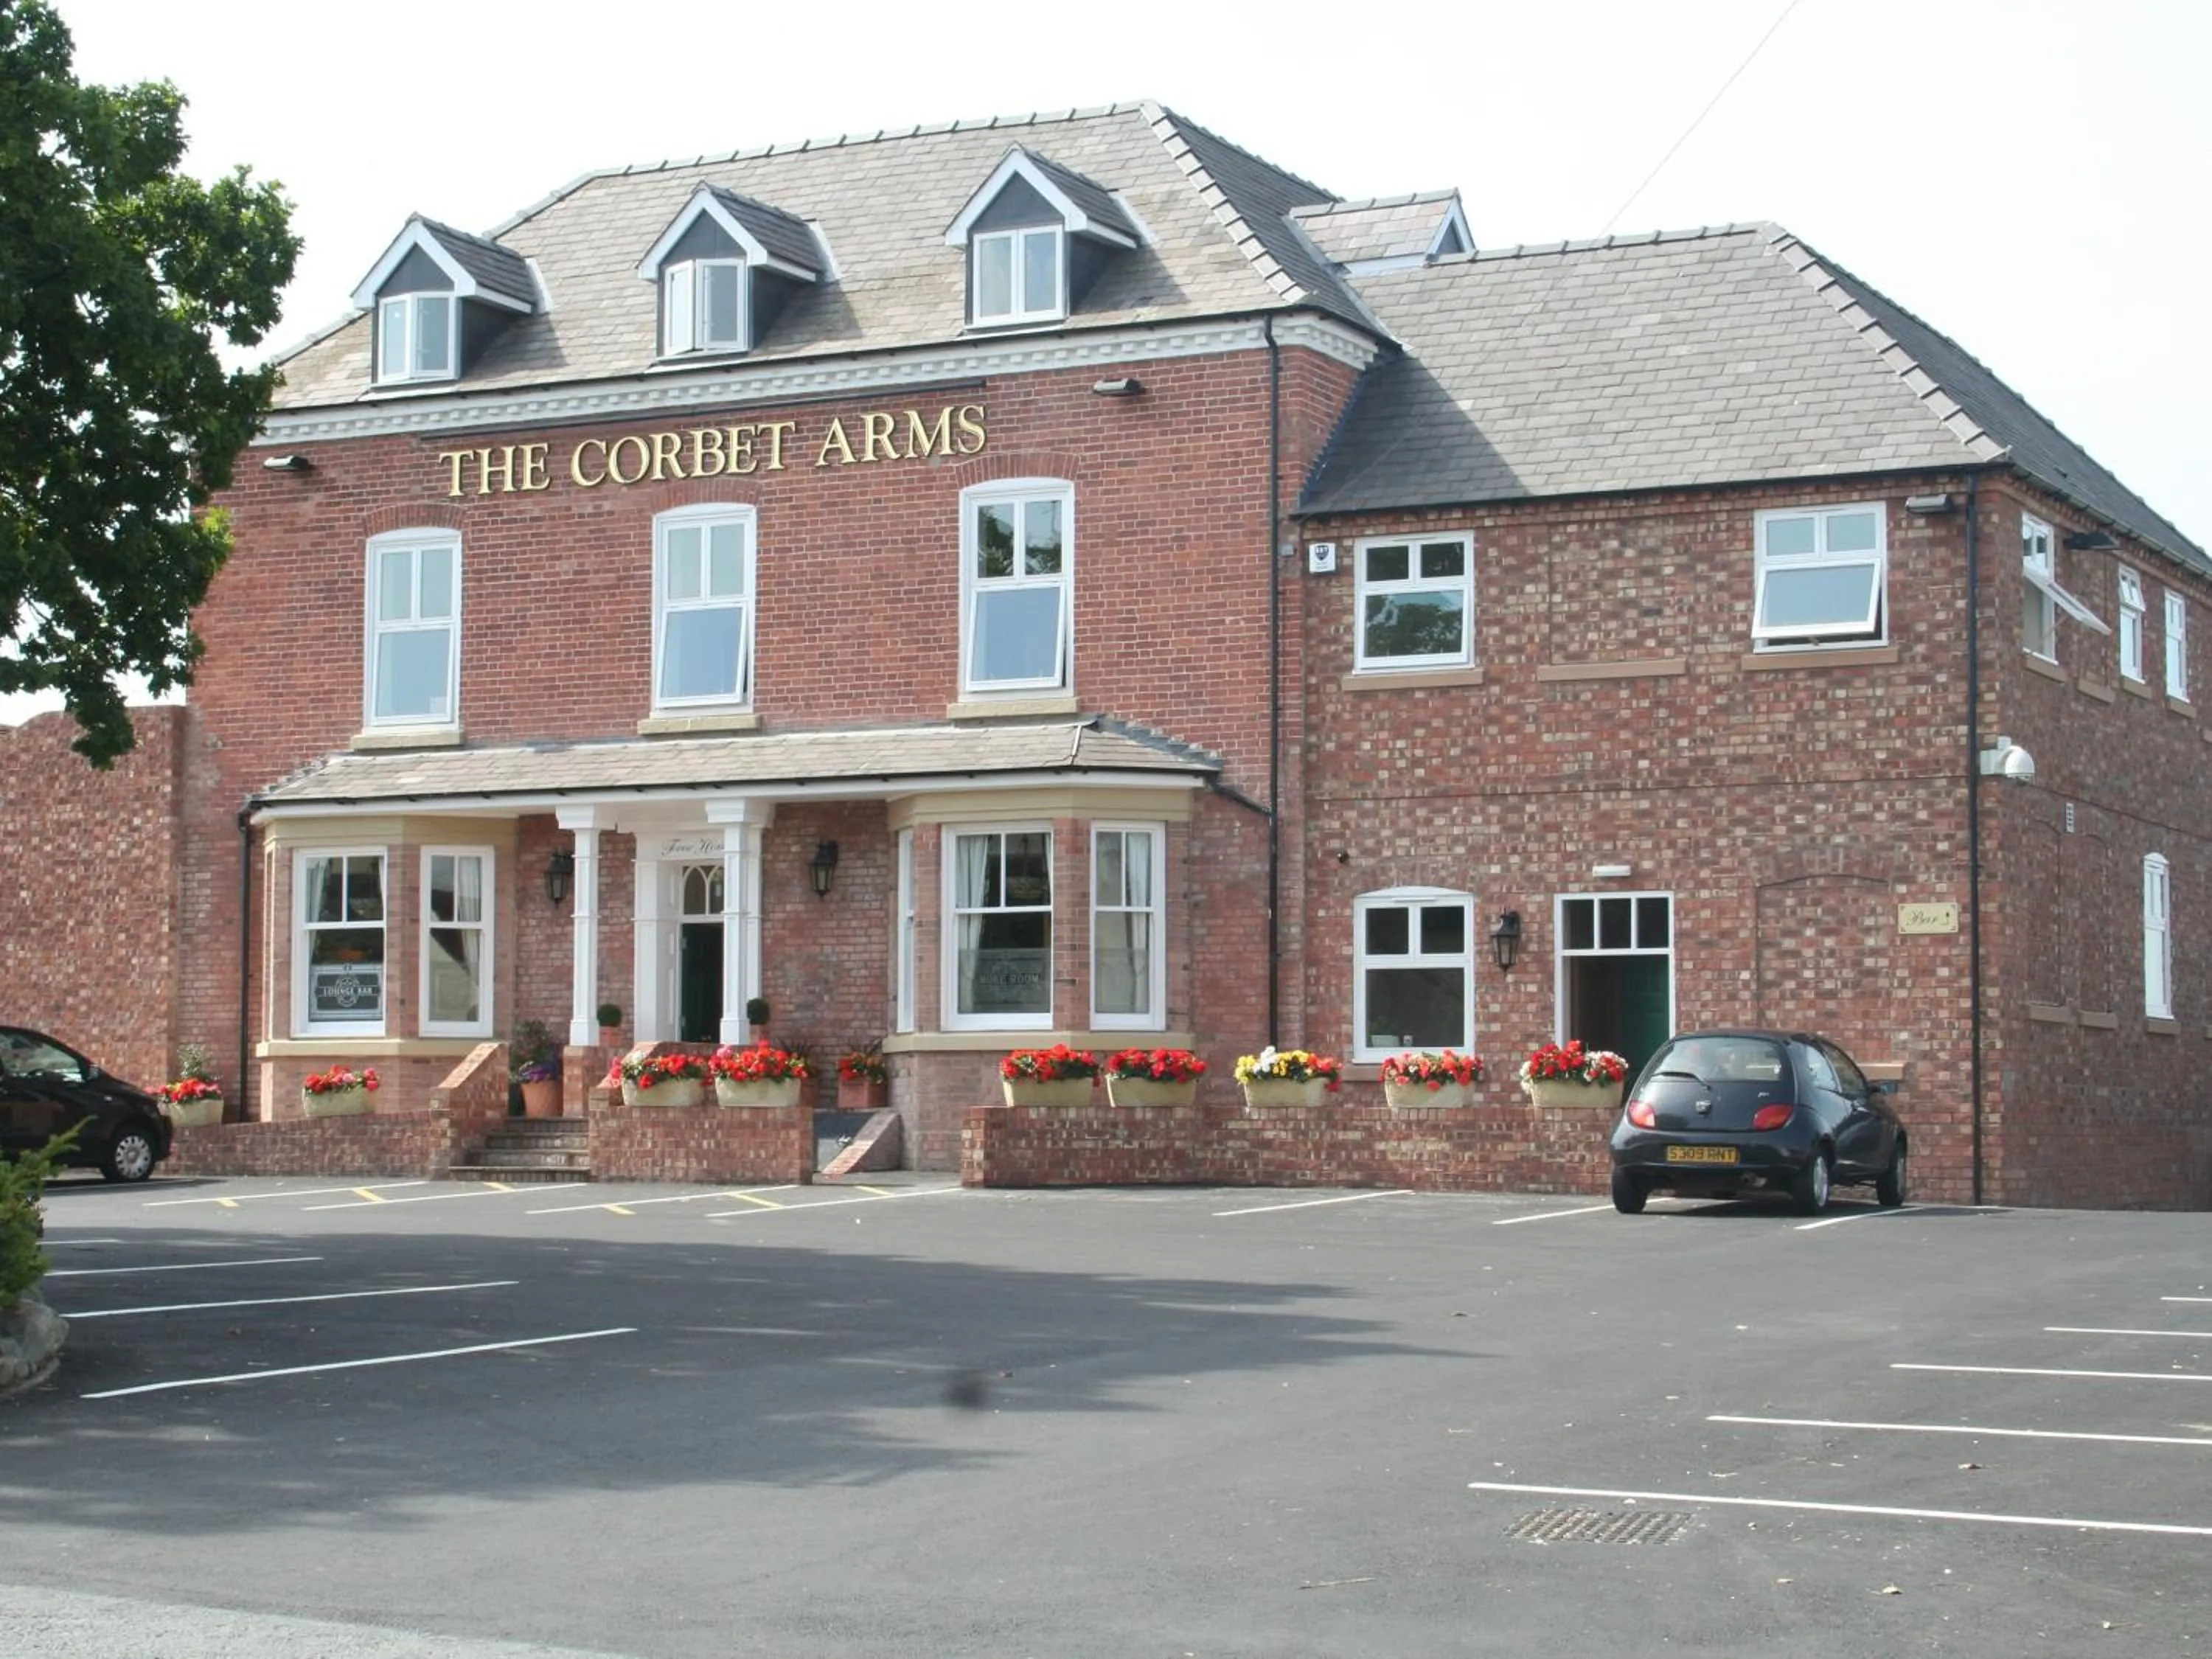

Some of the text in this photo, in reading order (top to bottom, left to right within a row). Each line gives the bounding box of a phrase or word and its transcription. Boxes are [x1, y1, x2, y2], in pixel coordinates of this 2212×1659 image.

[440, 404, 987, 497] THE CORBET ARMS
[972, 973, 1006, 985] MOKE
[323, 986, 372, 996] LOUNGE BAR
